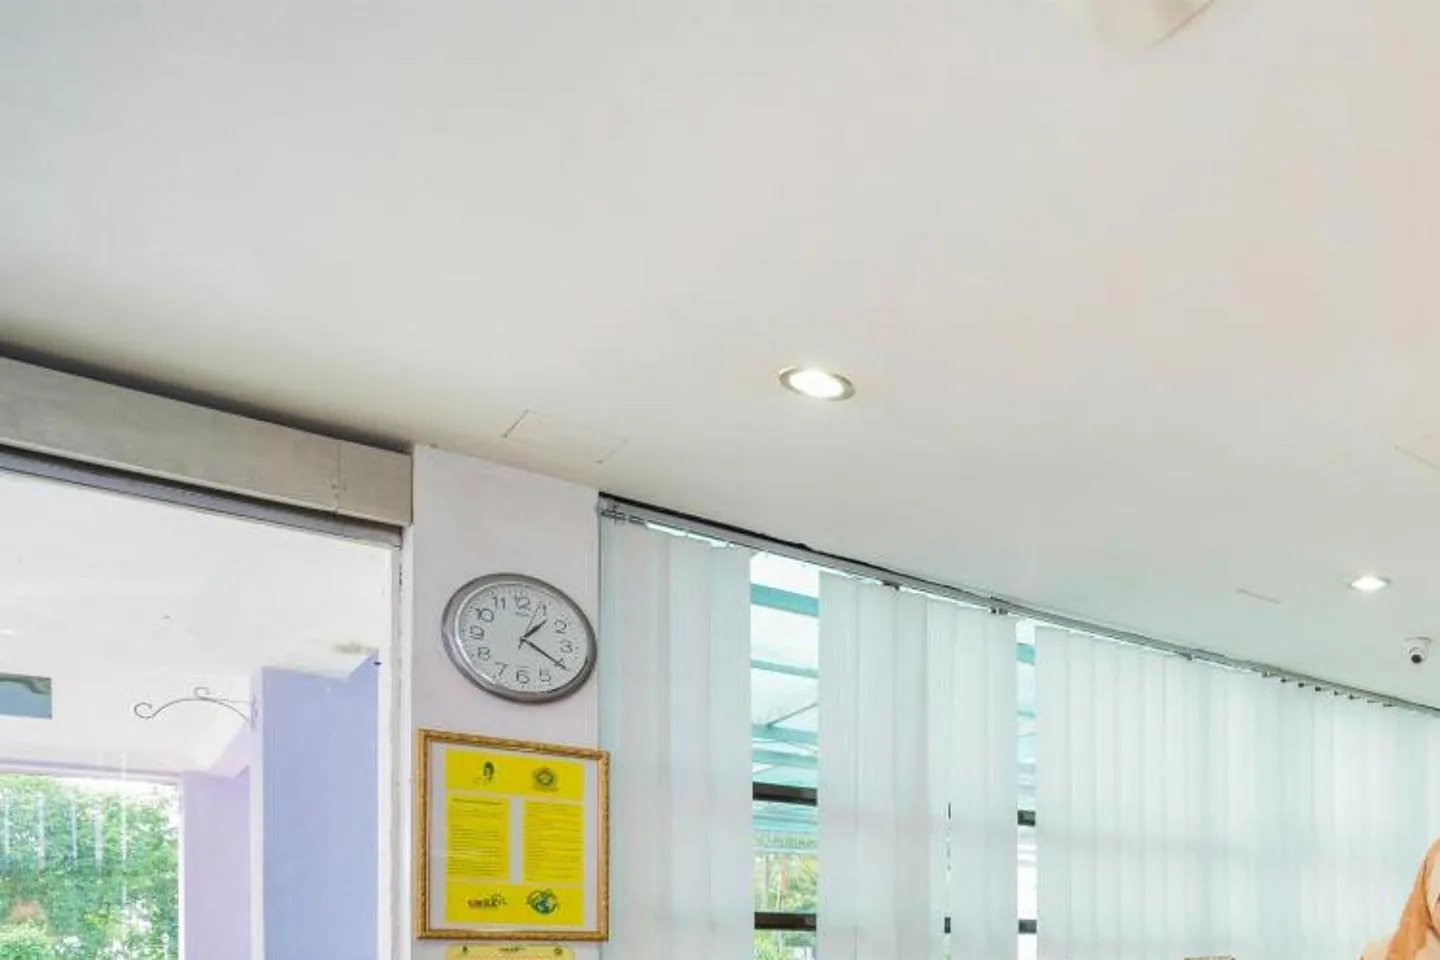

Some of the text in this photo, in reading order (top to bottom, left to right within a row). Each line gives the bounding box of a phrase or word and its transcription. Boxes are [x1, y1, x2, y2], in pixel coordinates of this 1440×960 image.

[492, 596, 506, 610] 11
[514, 595, 531, 611] 12
[475, 607, 495, 623] 10
[469, 625, 485, 640] 9
[554, 619, 568, 635] 2
[477, 646, 491, 661] 8
[560, 640, 573, 654] 3
[494, 661, 509, 677] 7
[538, 668, 552, 682] 5
[515, 669, 531, 685] 6
